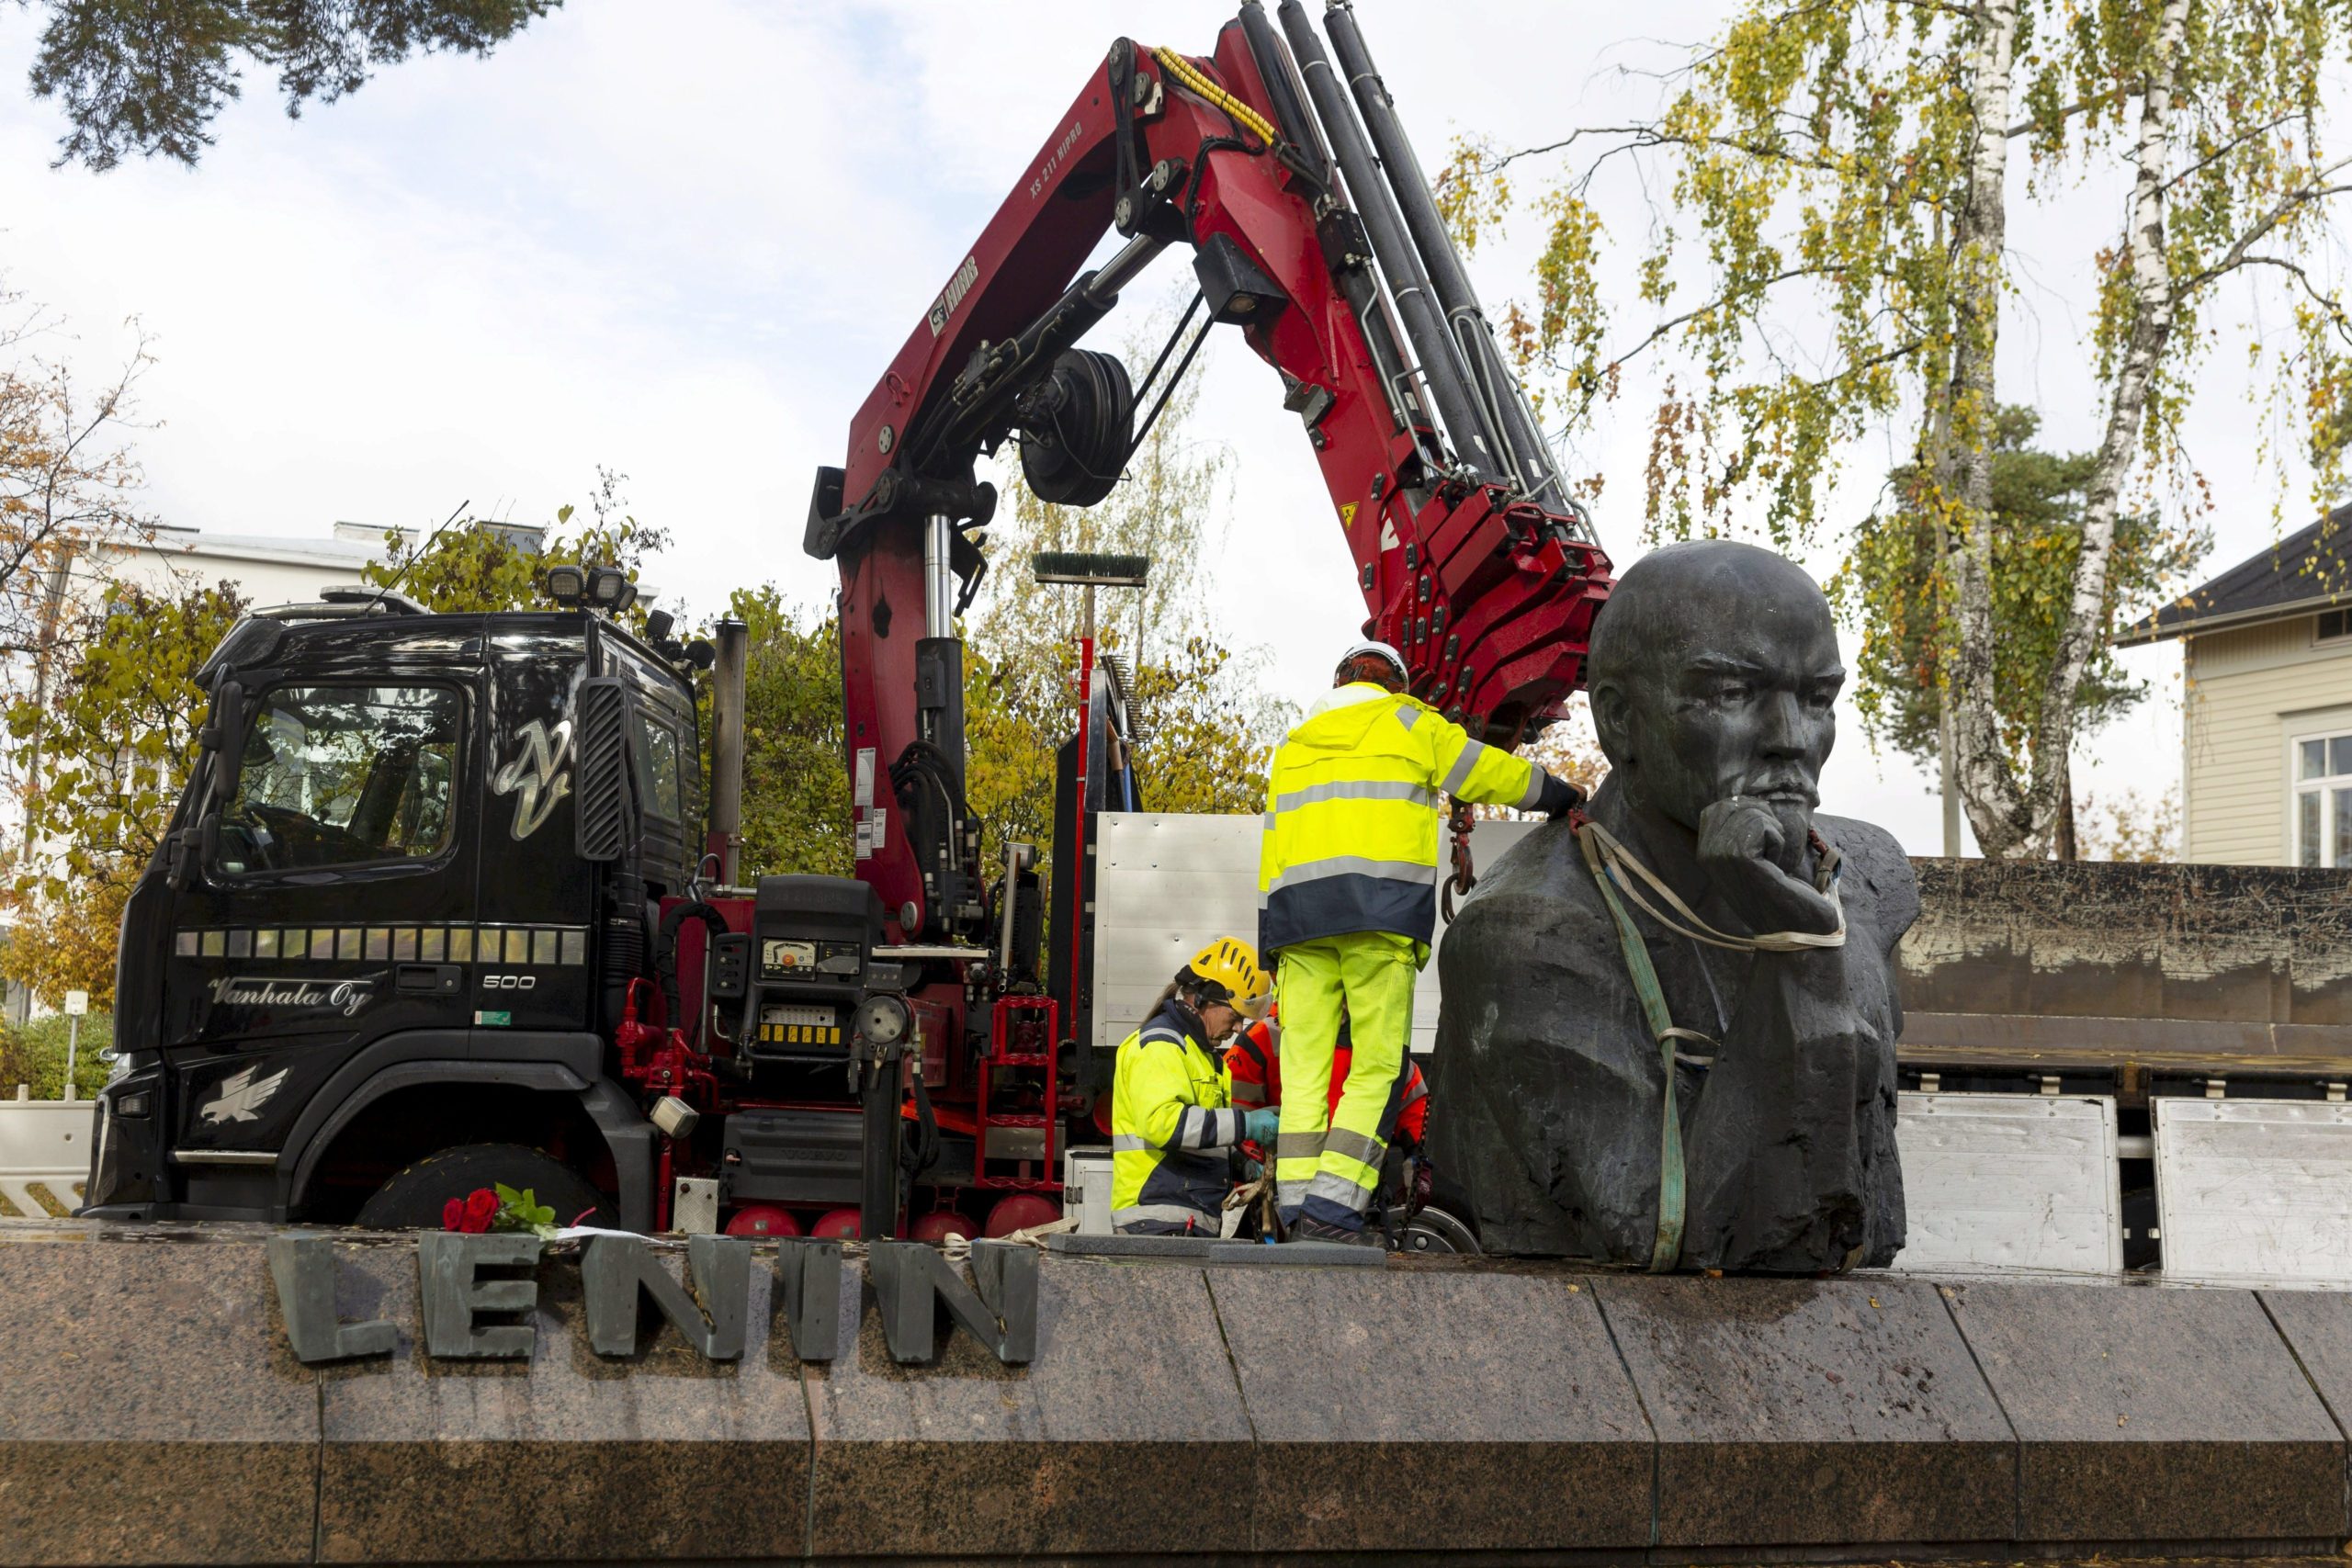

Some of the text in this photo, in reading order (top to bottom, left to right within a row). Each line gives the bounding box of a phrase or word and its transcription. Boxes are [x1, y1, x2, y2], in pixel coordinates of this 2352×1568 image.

[1029, 121, 1082, 199] XS 211 HIPRO
[208, 976, 373, 1016] Vanhala Oy
[482, 975, 536, 990] 500
[267, 1230, 1039, 1363] LENIN
